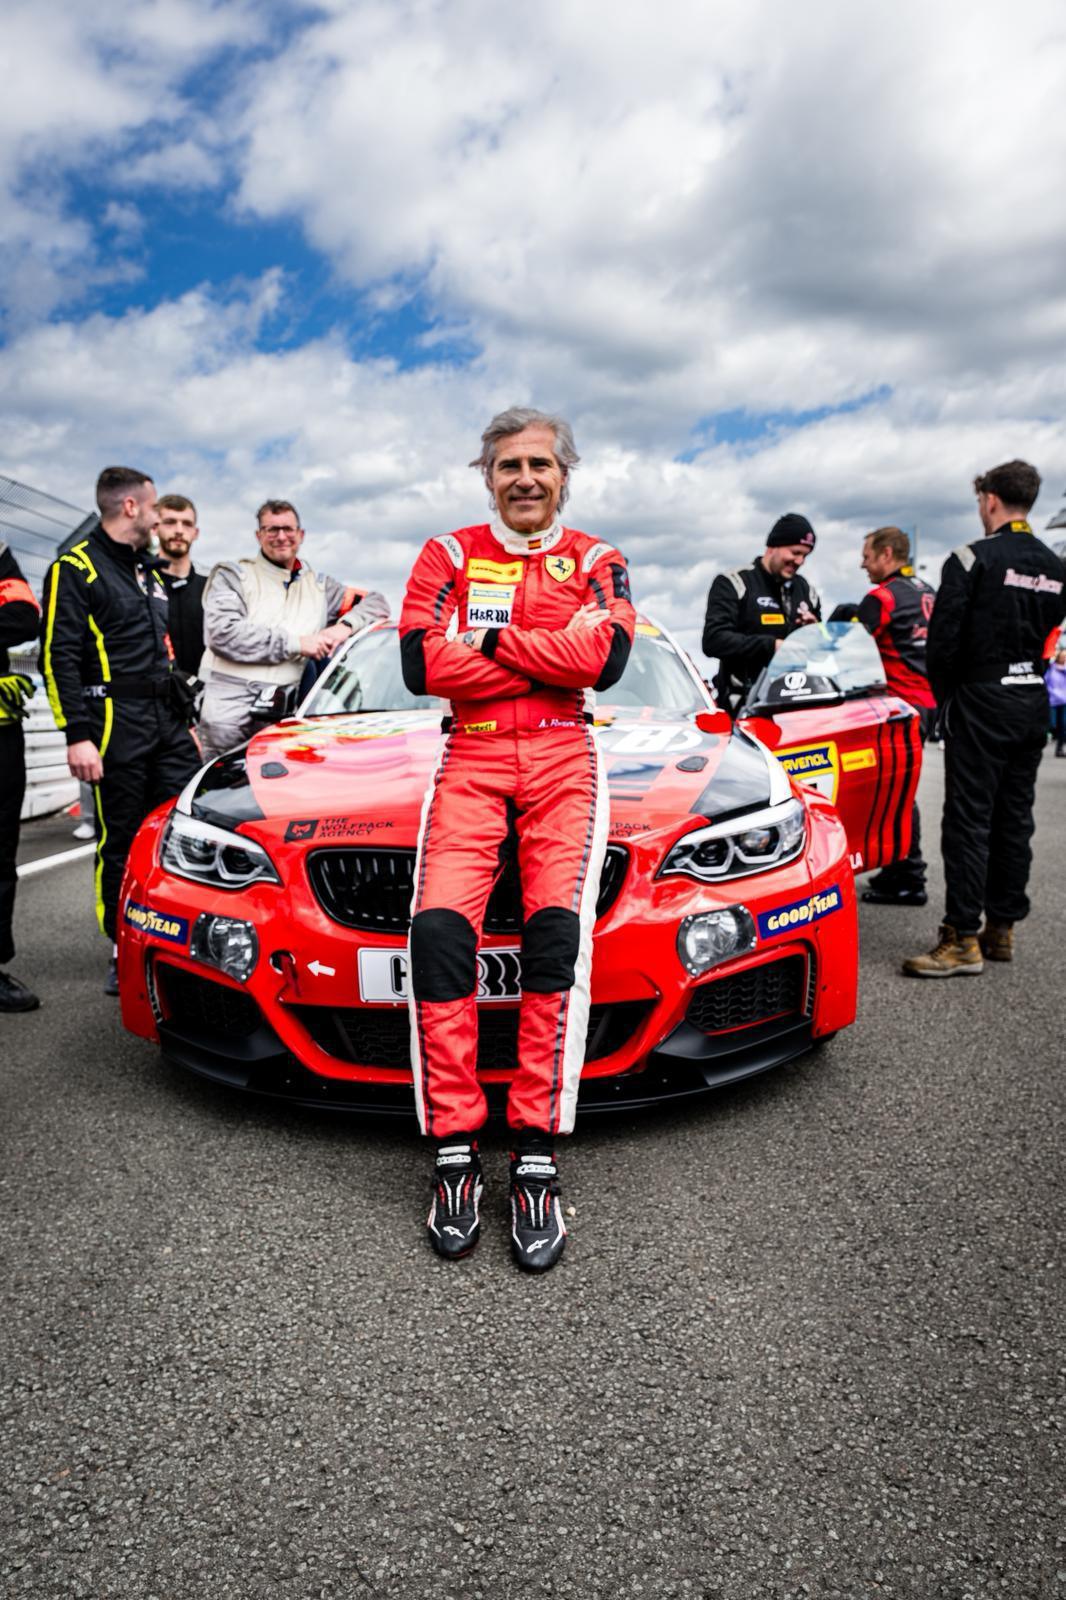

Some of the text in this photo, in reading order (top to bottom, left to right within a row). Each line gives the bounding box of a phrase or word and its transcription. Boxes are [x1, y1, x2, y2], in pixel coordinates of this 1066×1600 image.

[469, 608, 494, 621] H&R
[782, 753, 829, 772] AVENOL
[320, 821, 394, 832] WOLFPACK
[325, 817, 349, 825] THE
[610, 822, 652, 831] PACK
[319, 828, 373, 838] AGENCY
[767, 892, 838, 931] GOODYEAR
[127, 906, 181, 937] GOODYEAR
